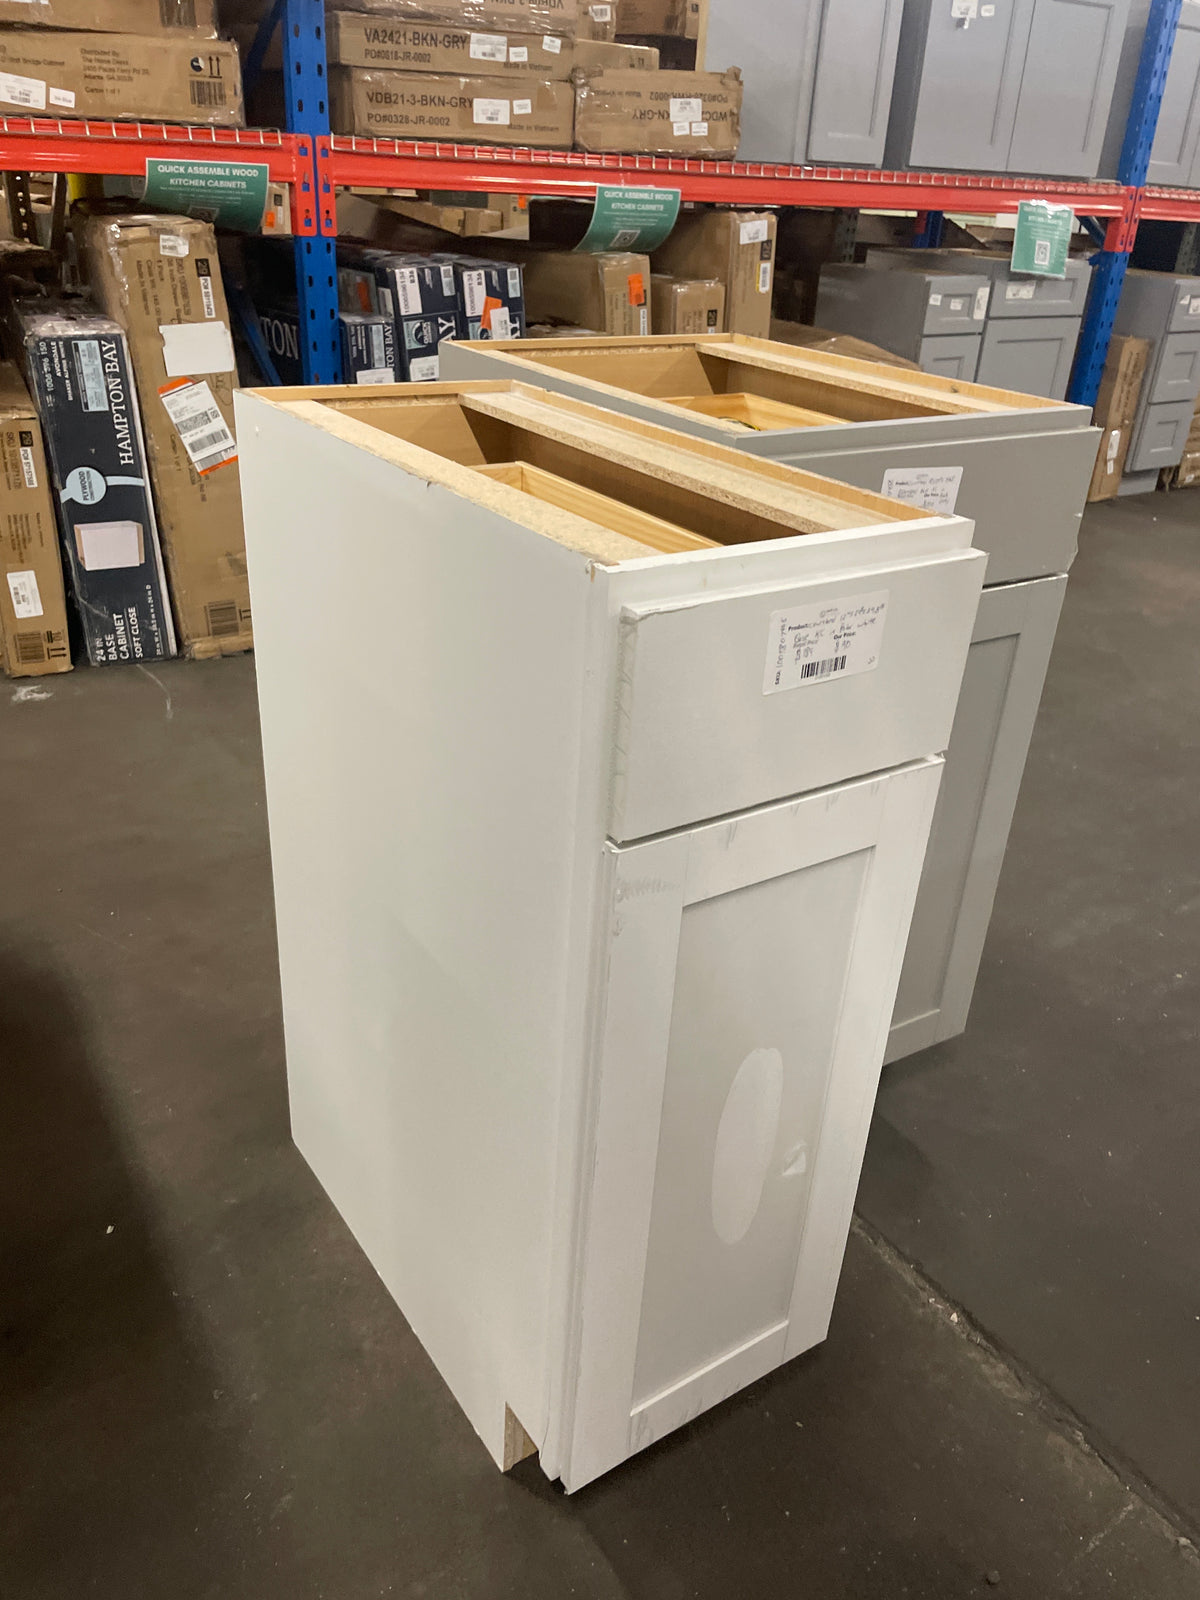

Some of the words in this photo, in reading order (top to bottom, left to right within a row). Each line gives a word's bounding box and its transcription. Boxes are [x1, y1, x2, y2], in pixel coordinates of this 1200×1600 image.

[364, 28, 468, 49] VA2421-BKN-GRY
[366, 92, 473, 108] VDB21-3-BKN-GRY
[158, 165, 185, 174] QUICK
[188, 166, 230, 175] ASSEMBLE
[232, 168, 259, 177] WOOD
[170, 178, 205, 187] KITCHEN
[207, 179, 246, 188] CABINETS
[384, 324, 392, 344] BAY
[39, 341, 47, 355] 150
[101, 340, 120, 373] BAY
[51, 341, 62, 377] AVONDALE
[107, 378, 134, 466] HAMPTON
[79, 471, 89, 500] PLYWOOD
[128, 607, 139, 634] CLOSE
[113, 613, 129, 659] CABINET
[96, 650, 106, 661] 24
[105, 634, 117, 660] BASE
[133, 637, 143, 658] SOFT
